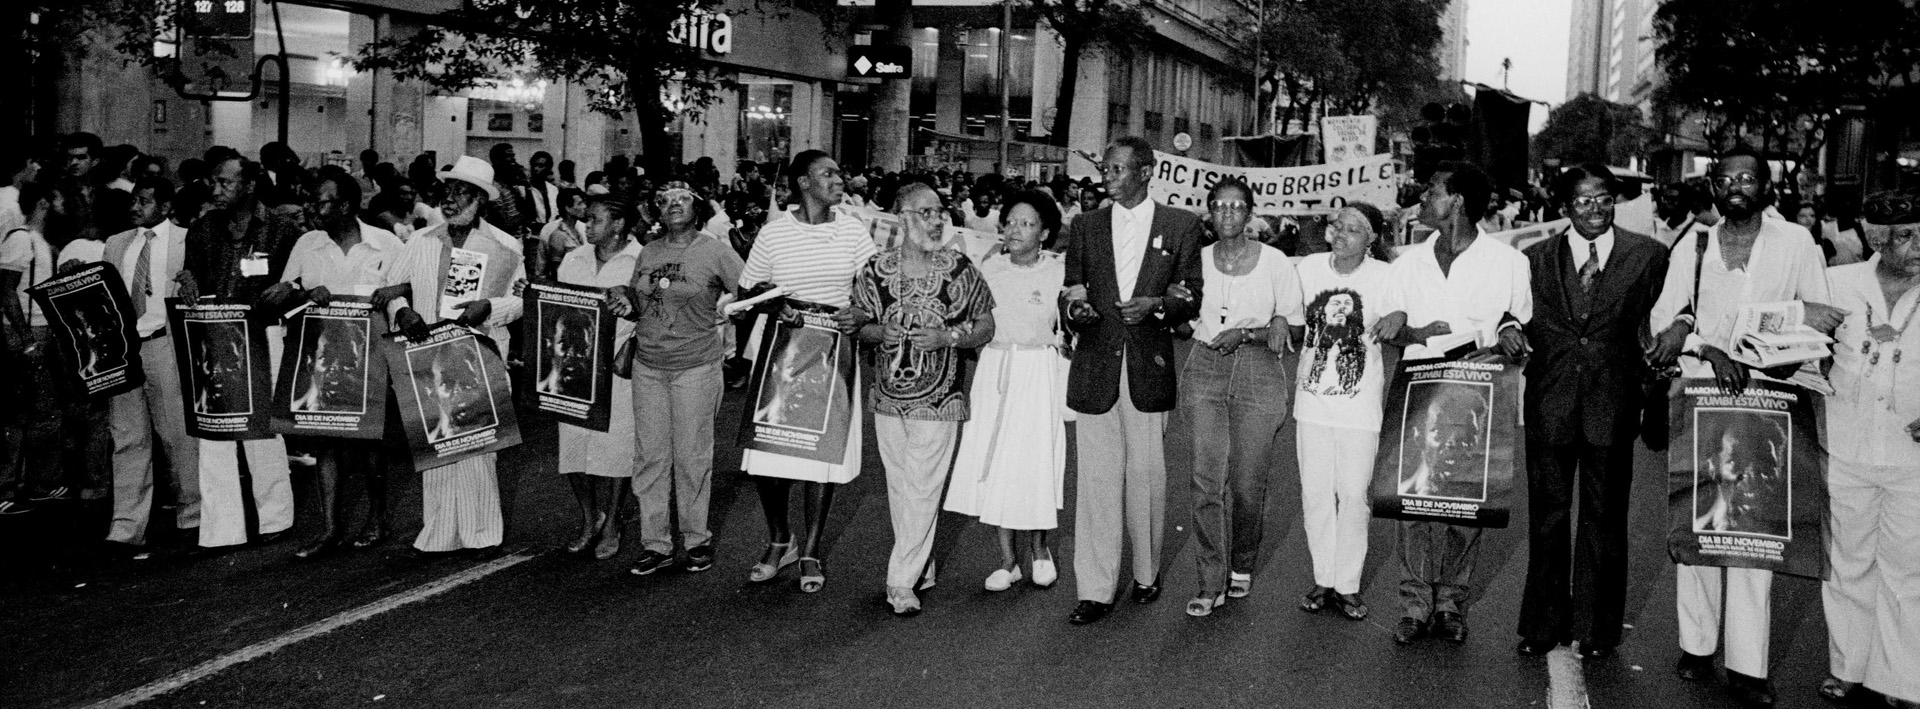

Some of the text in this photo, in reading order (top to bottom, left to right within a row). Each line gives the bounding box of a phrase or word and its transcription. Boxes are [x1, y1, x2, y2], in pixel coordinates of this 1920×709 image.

[194, 0, 245, 14] 127 128
[875, 61, 904, 73] Safra
[1251, 182, 1277, 196] NO
[1282, 165, 1370, 196] BRASIL
[81, 273, 101, 285] VIVO
[539, 291, 562, 301] ZUMBI
[580, 297, 598, 307] VIVO
[222, 311, 245, 319] VIVO
[305, 306, 369, 317] ZUMBI ESTÁ VIVO
[1404, 361, 1504, 373] MARCHA CONTRA O RACISMO
[1411, 369, 1492, 381] ZUMBI ESTÁ VIVO
[1323, 385, 1361, 399] Marley
[1684, 386, 1720, 395] MARCHA
[1756, 388, 1764, 396] O
[1764, 389, 1798, 401] RACISMO
[1696, 395, 1789, 410] ZUMBI ESTÁ VIVO
[322, 415, 360, 423] NOVEMBRO
[460, 428, 496, 444] NOVEMBRO
[1401, 498, 1415, 506] DIA
[1423, 500, 1434, 508] DE
[1434, 501, 1479, 512] NOVEMBRO
[1698, 535, 1713, 544] DIA
[1721, 536, 1733, 545] DE
[1733, 537, 1785, 550] NOVEMBRO
